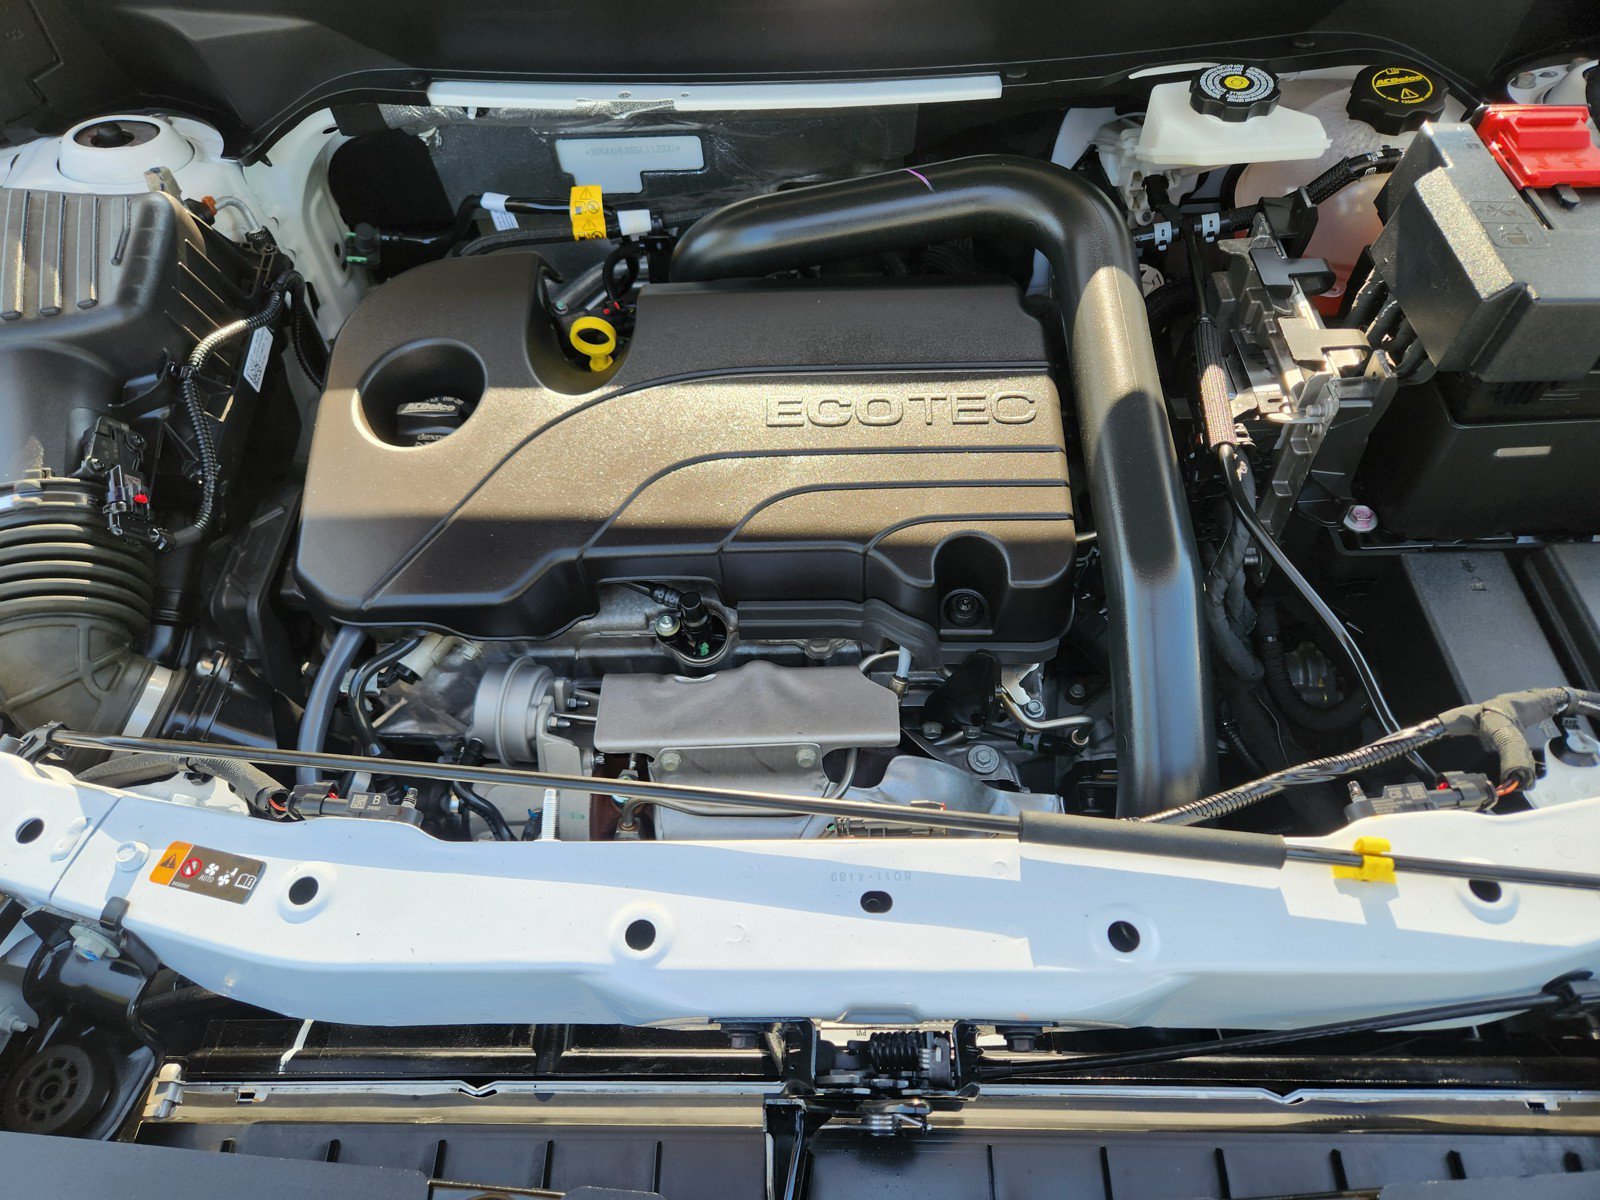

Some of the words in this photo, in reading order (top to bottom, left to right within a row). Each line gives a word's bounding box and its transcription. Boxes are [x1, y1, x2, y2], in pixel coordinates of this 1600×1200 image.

[1376, 75, 1423, 87] ACDelco
[401, 402, 456, 413] ACDelco
[766, 390, 1037, 427] ECOTEC
[372, 795, 382, 805] B
[198, 874, 215, 883] AUTO
